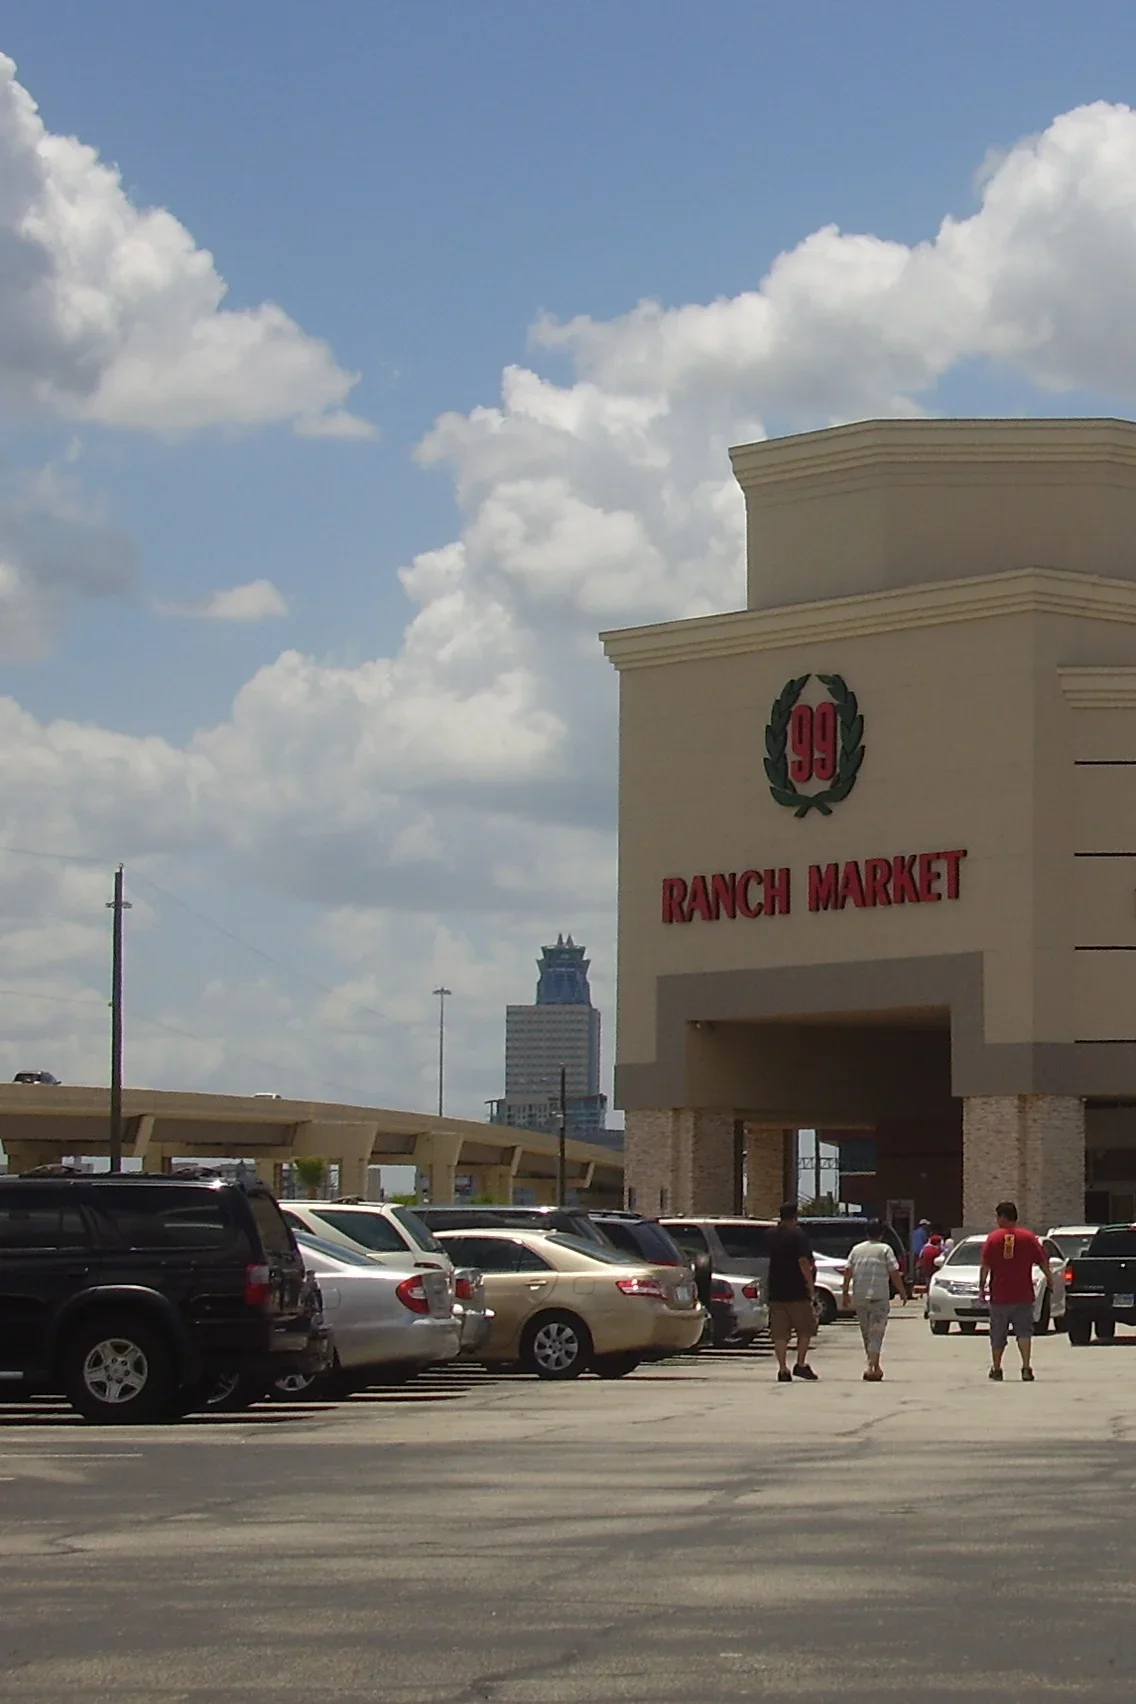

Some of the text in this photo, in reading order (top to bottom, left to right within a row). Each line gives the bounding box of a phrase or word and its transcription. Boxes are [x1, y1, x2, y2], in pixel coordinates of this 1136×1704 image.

[790, 702, 837, 782] 99
[662, 849, 967, 923] RANCH MARKET
